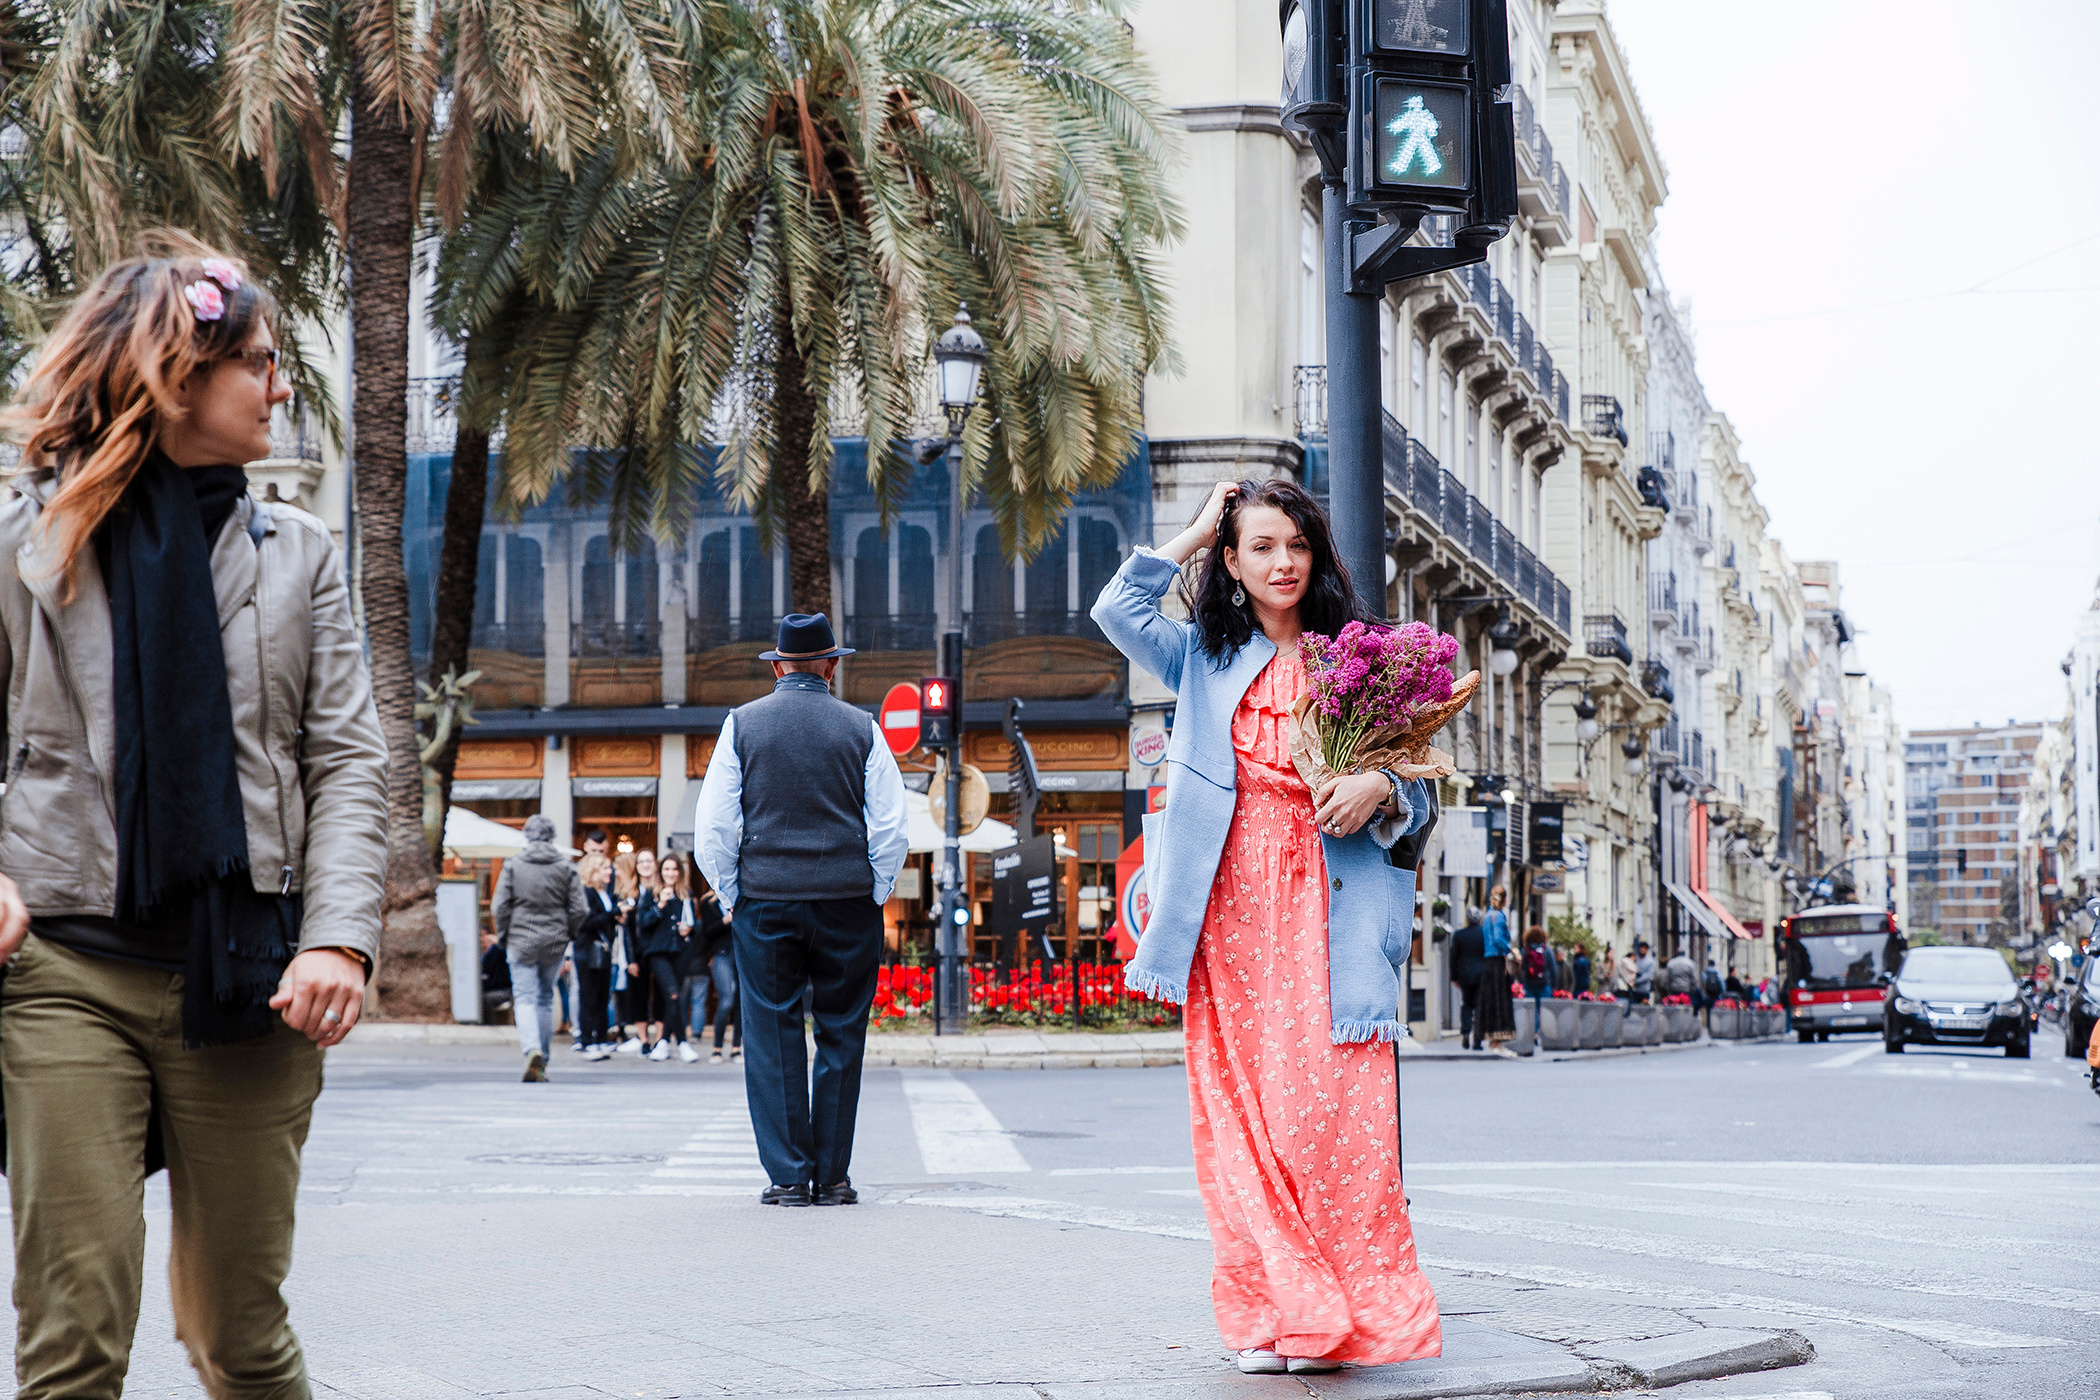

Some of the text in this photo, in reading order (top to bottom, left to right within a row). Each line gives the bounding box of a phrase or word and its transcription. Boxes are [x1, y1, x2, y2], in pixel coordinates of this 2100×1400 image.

[998, 742, 1094, 752] CPUCCINO
[1135, 734, 1163, 748] BURGER
[1137, 740, 1165, 758] KING
